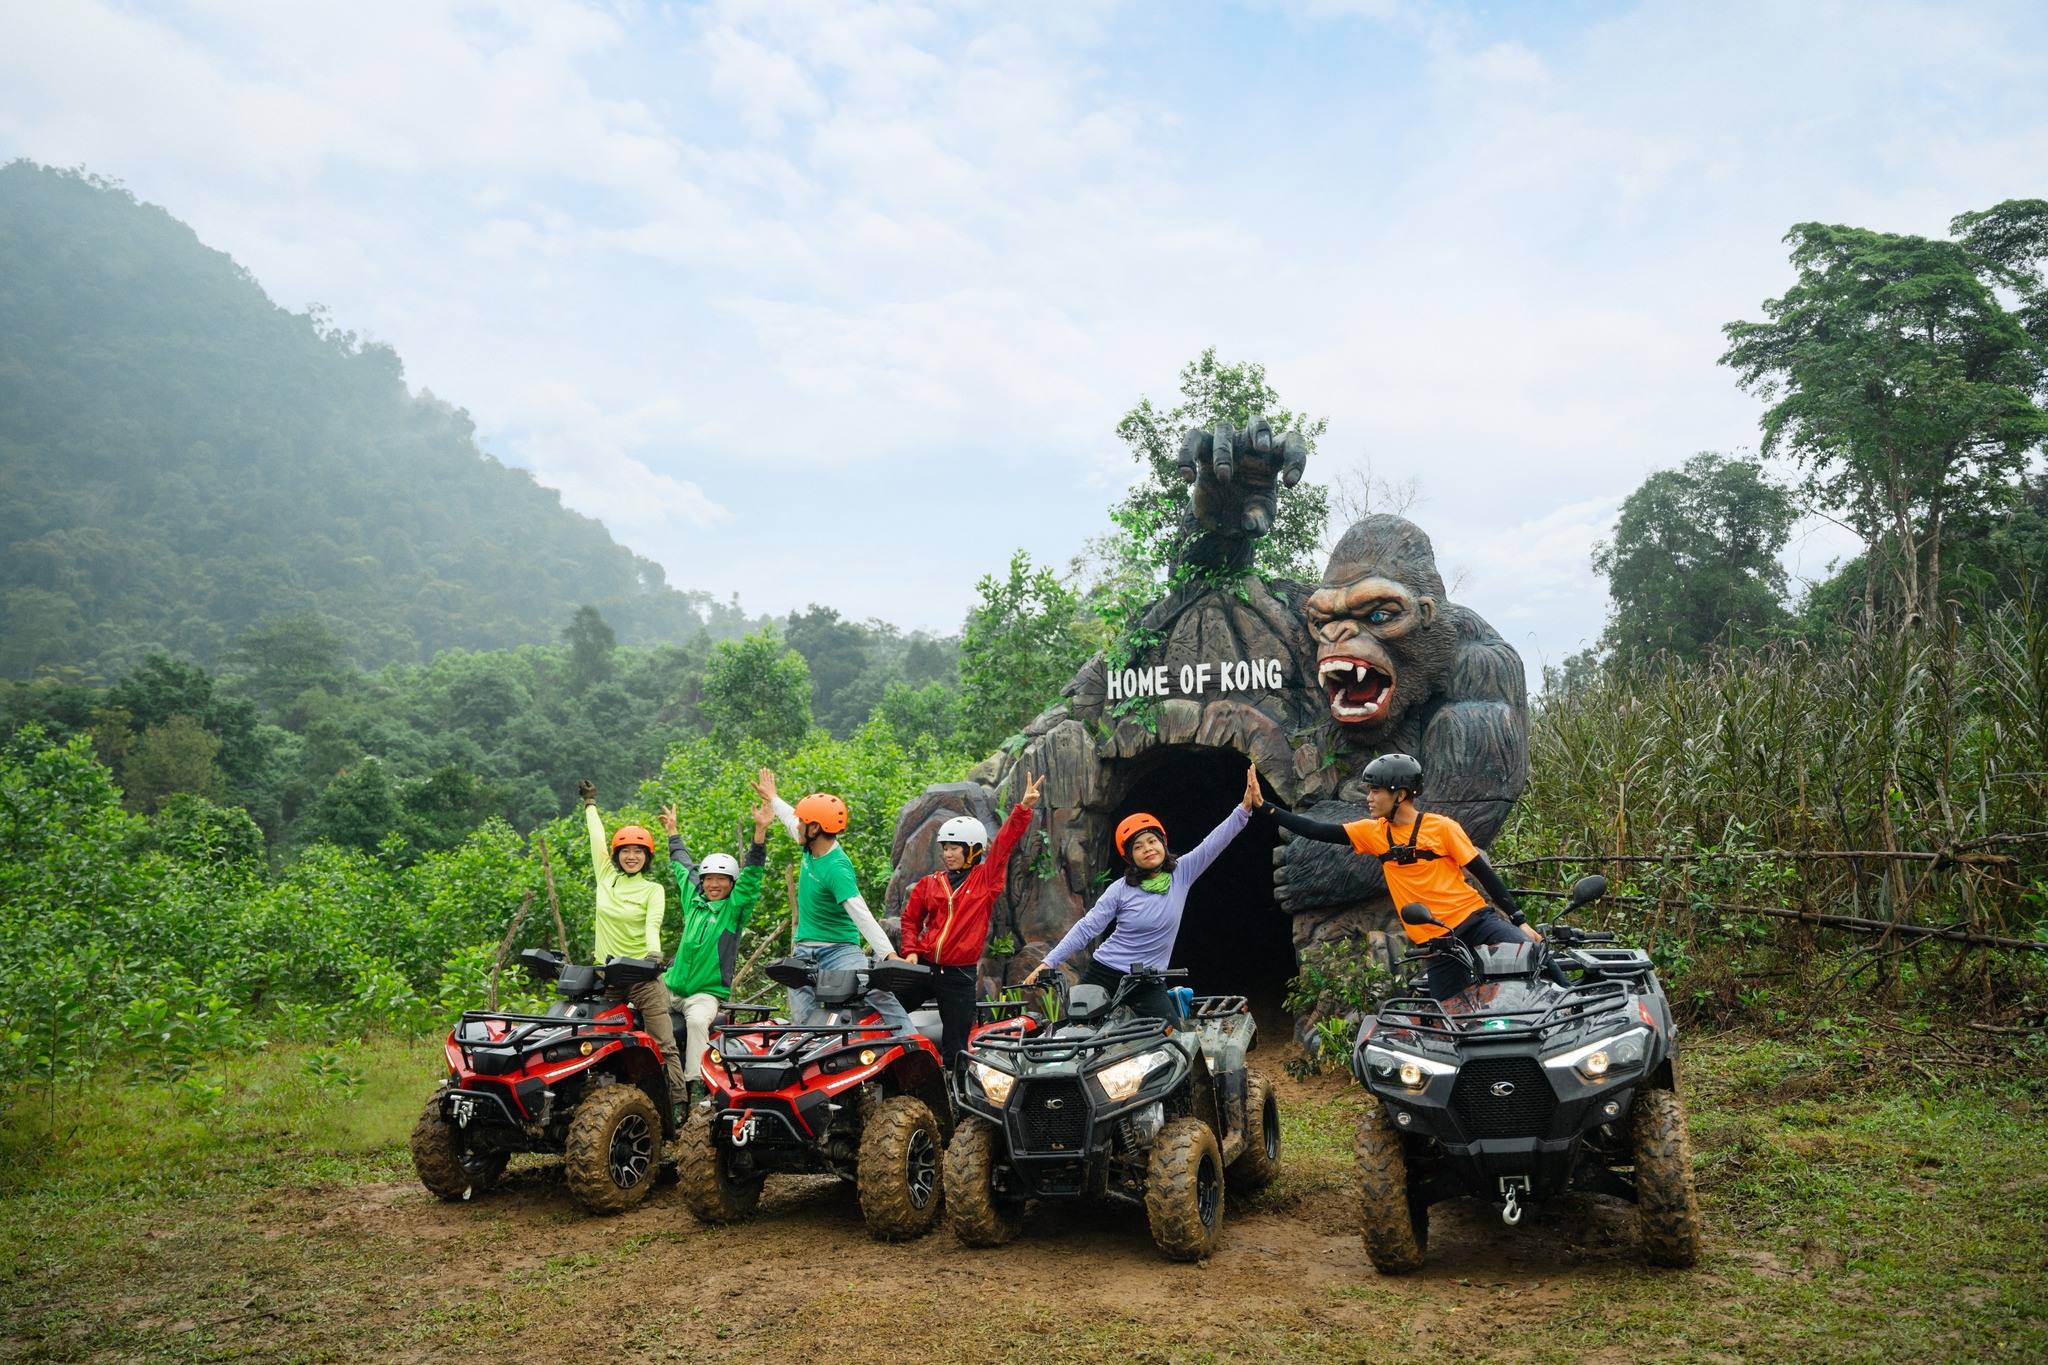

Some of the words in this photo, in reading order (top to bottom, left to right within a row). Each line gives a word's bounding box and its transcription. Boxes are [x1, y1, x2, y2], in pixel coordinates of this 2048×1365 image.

[1107, 665, 1170, 700] HOME
[1179, 663, 1211, 695] OF
[1220, 658, 1283, 692] KONG
